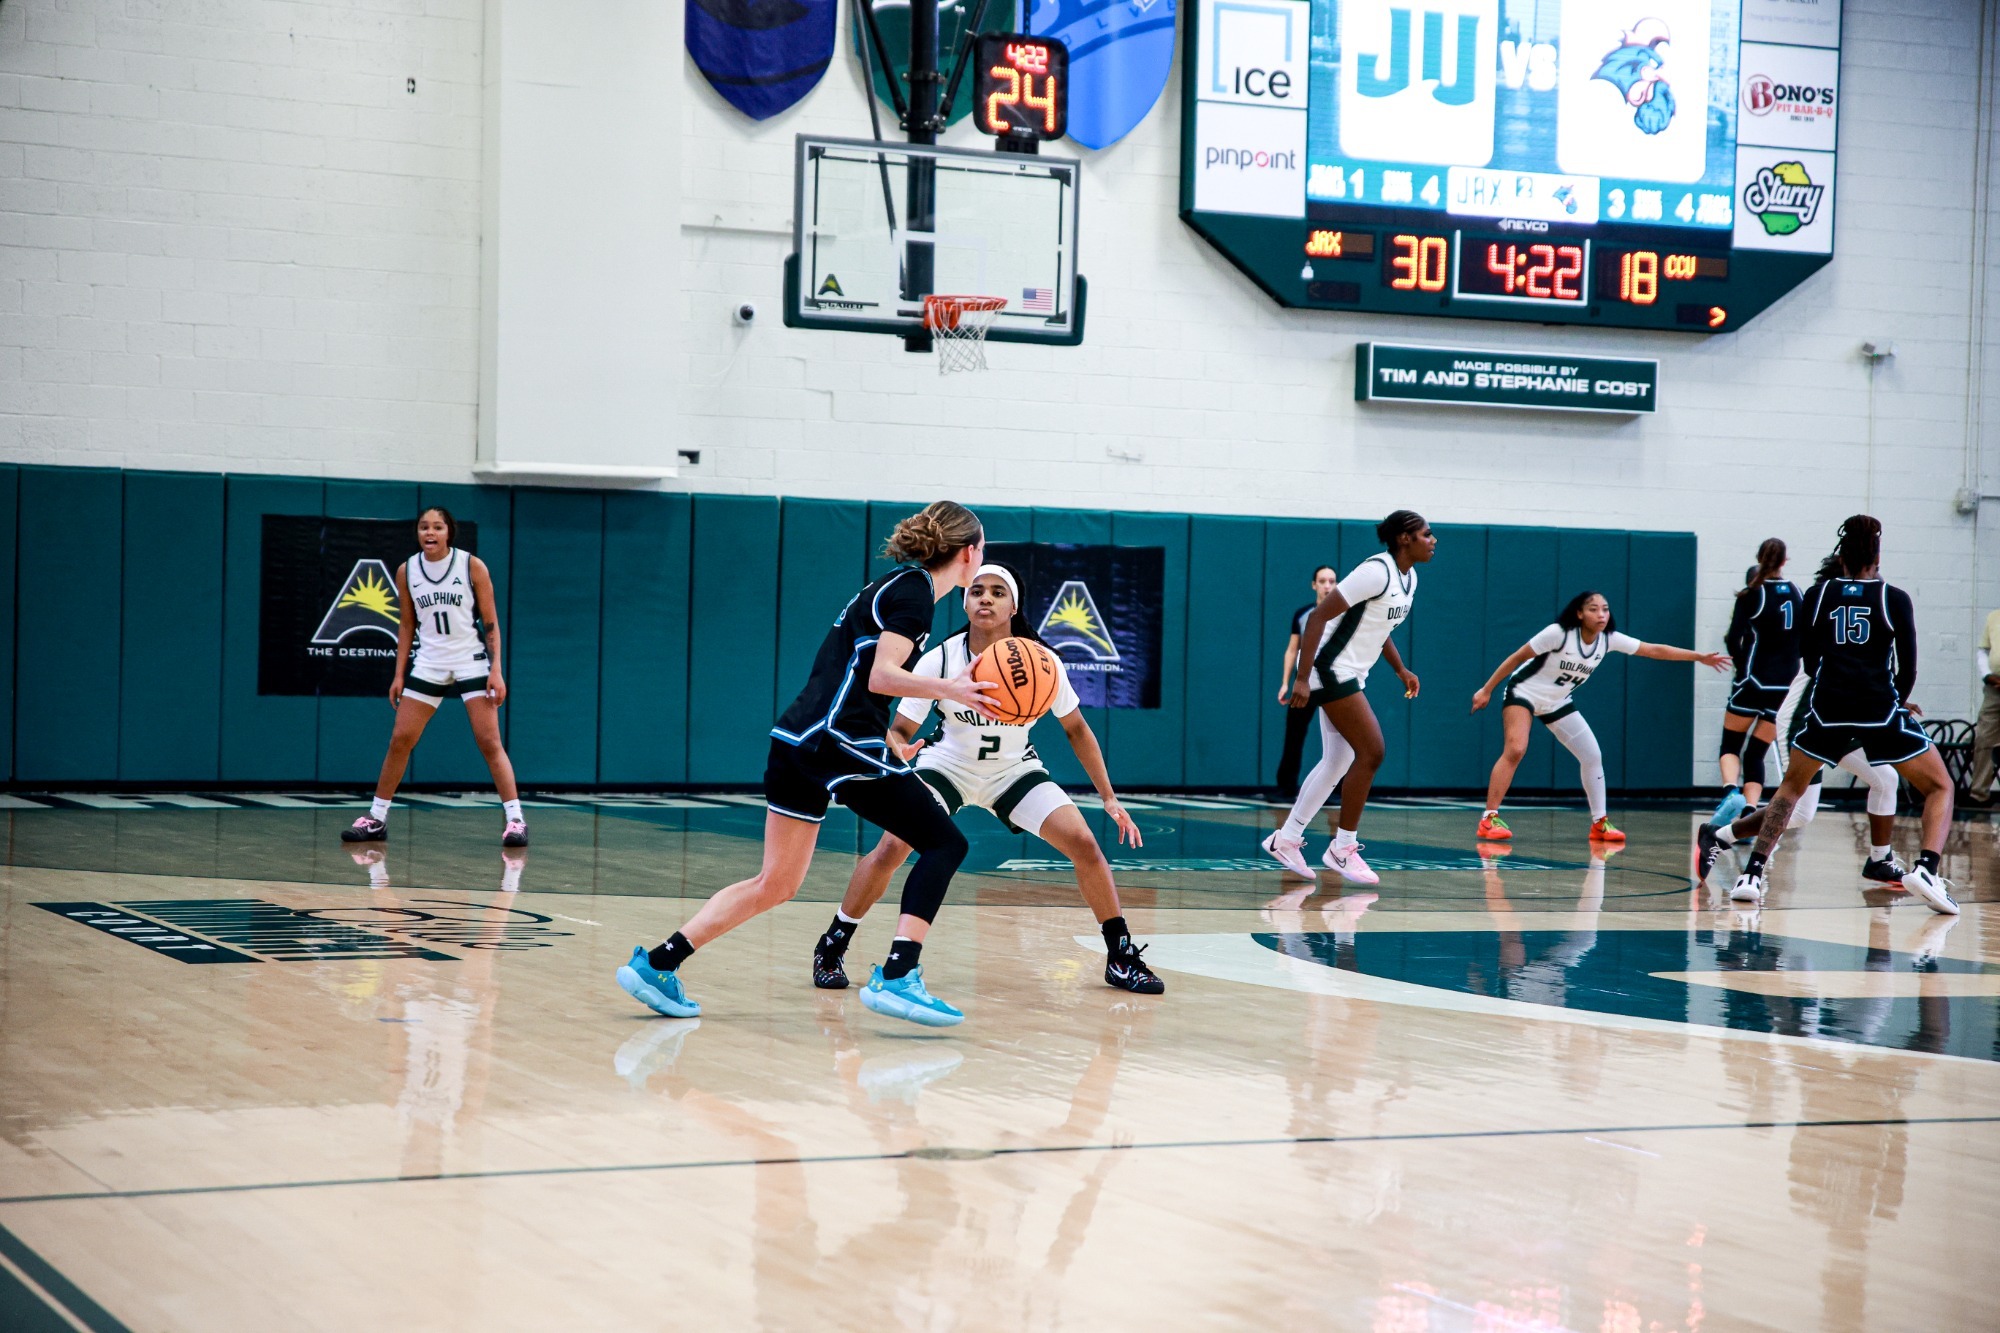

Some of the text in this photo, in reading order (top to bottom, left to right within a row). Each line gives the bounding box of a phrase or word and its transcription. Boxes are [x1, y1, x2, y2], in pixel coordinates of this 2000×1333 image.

[1006, 43, 1049, 74] 4:22
[1500, 40, 1558, 91] VS
[988, 65, 1056, 132] 24
[1751, 81, 1834, 110] BONO'S
[1776, 103, 1792, 113] PIT
[1206, 147, 1296, 170] pinpoint
[1744, 167, 1825, 226] Starry
[1306, 230, 1342, 257] JAX
[1392, 235, 1448, 291] 30
[1488, 243, 1582, 299] 4:22
[1620, 251, 1659, 305] 18
[1380, 368, 1651, 397] TIM AND STEPHANIE COST
[1454, 360, 1579, 377] MADE POSSIBLE BY
[416, 591, 463, 610] DOLPHINS
[1780, 600, 1793, 630] 1
[433, 611, 451, 635] 11
[1829, 605, 1871, 645] 15
[307, 647, 333, 656] THE
[1005, 639, 1029, 689] Wilson
[1063, 662, 1124, 672] STINATION.
[1554, 672, 1586, 690] 24
[978, 734, 1001, 761] 2
[66, 911, 217, 950] COURT
